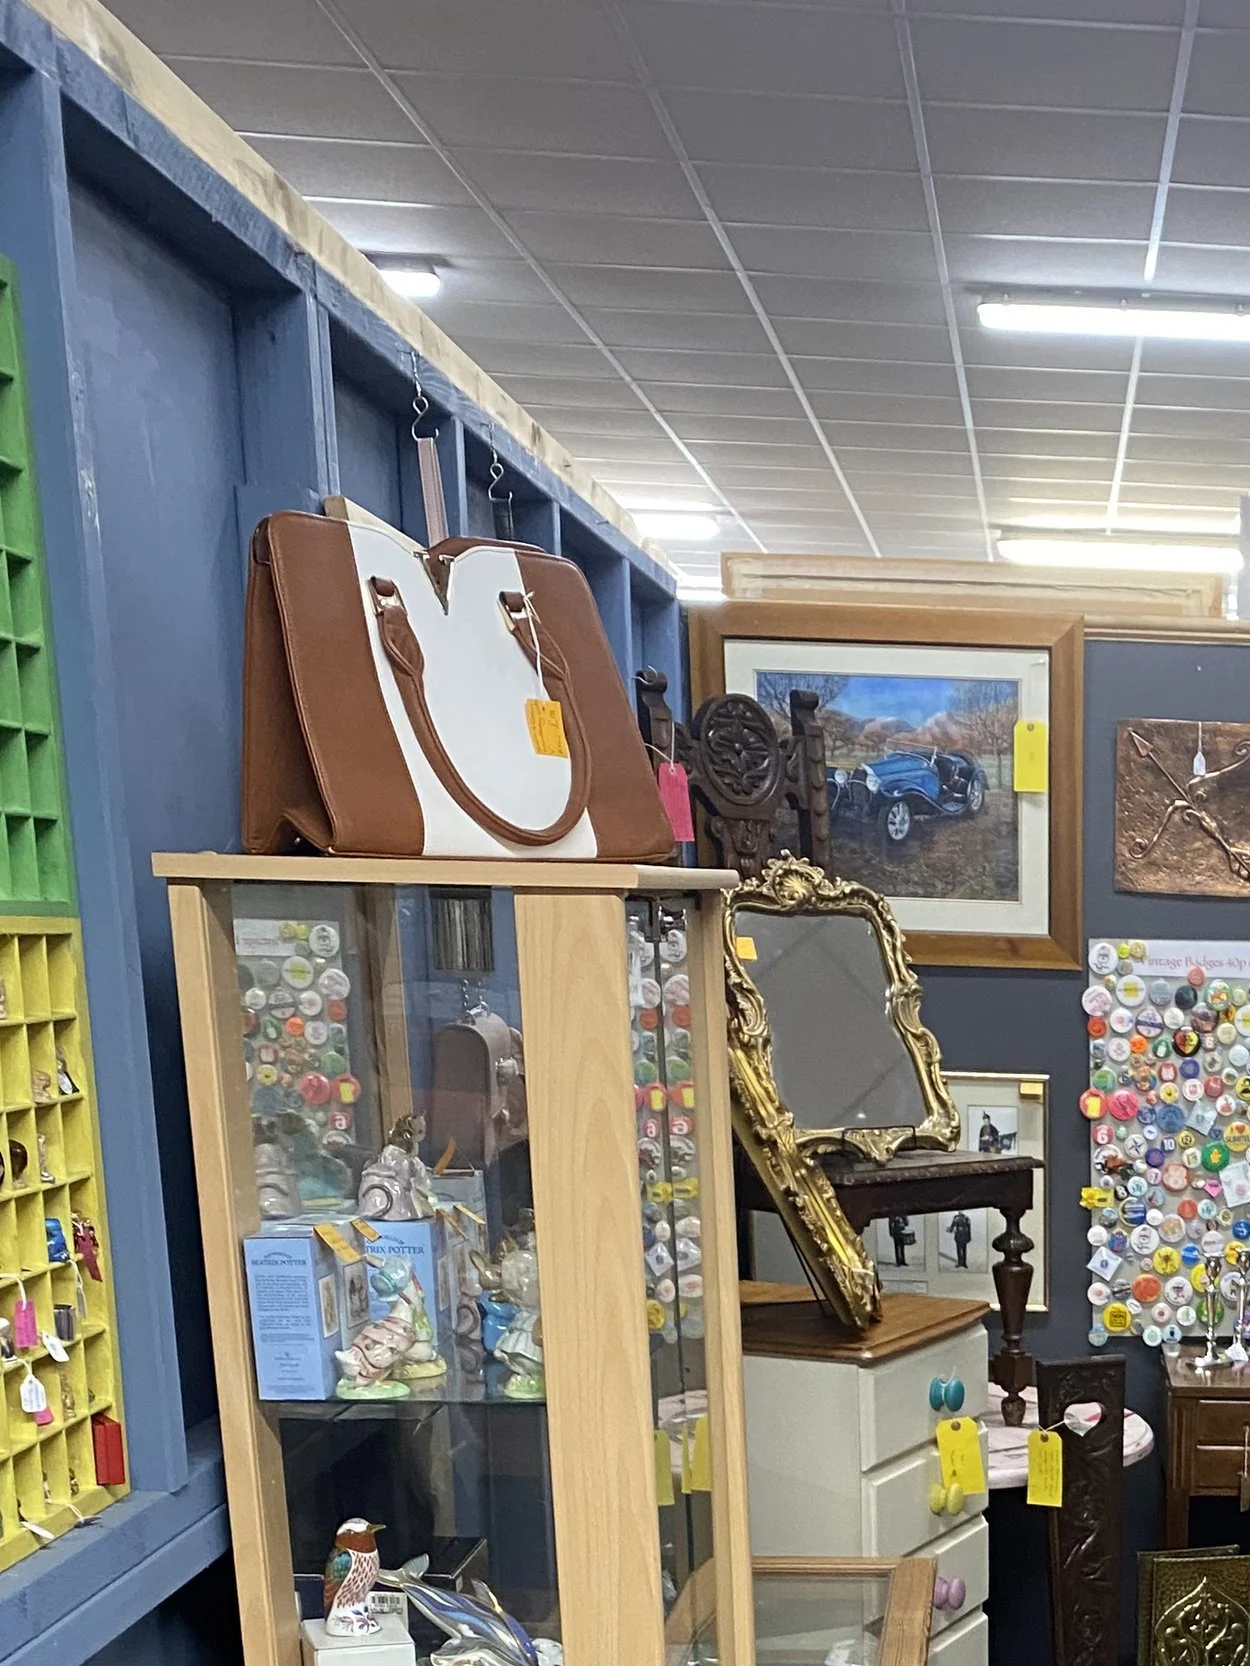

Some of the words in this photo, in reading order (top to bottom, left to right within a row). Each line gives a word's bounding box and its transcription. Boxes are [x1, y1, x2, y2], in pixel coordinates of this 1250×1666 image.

[1163, 1138, 1175, 1151] 10
[365, 1245, 386, 1254] TRIX
[387, 1245, 425, 1254] POTTER
[251, 1258, 279, 1267] BEATRIX
[280, 1258, 308, 1267] POTTER
